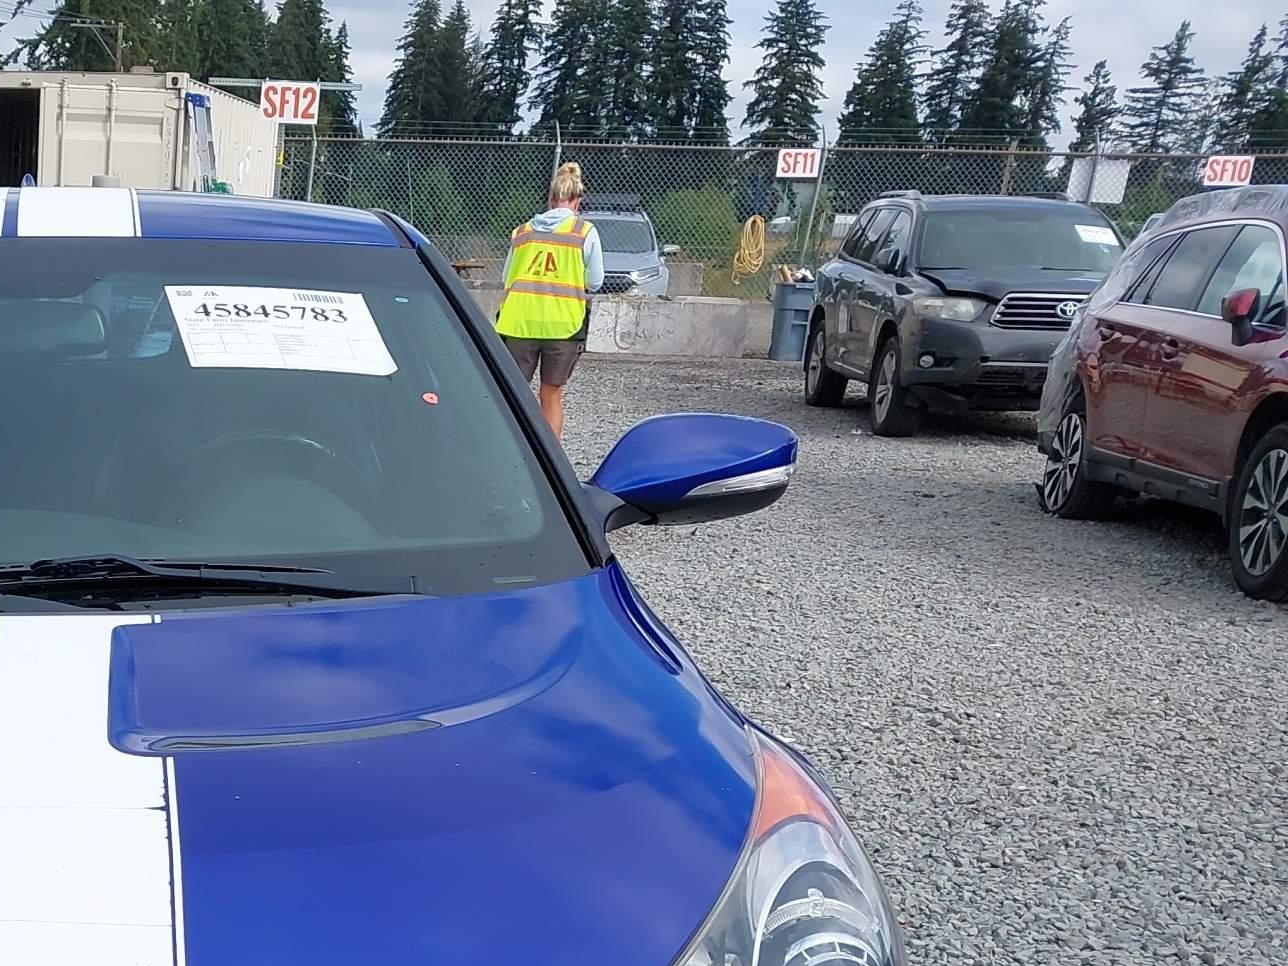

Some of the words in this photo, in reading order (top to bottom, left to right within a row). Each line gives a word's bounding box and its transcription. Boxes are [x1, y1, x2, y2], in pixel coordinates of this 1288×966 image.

[263, 85, 317, 119] SF12
[781, 152, 816, 173] SF11
[1207, 159, 1251, 182] SF10
[194, 303, 348, 323] 45845783
